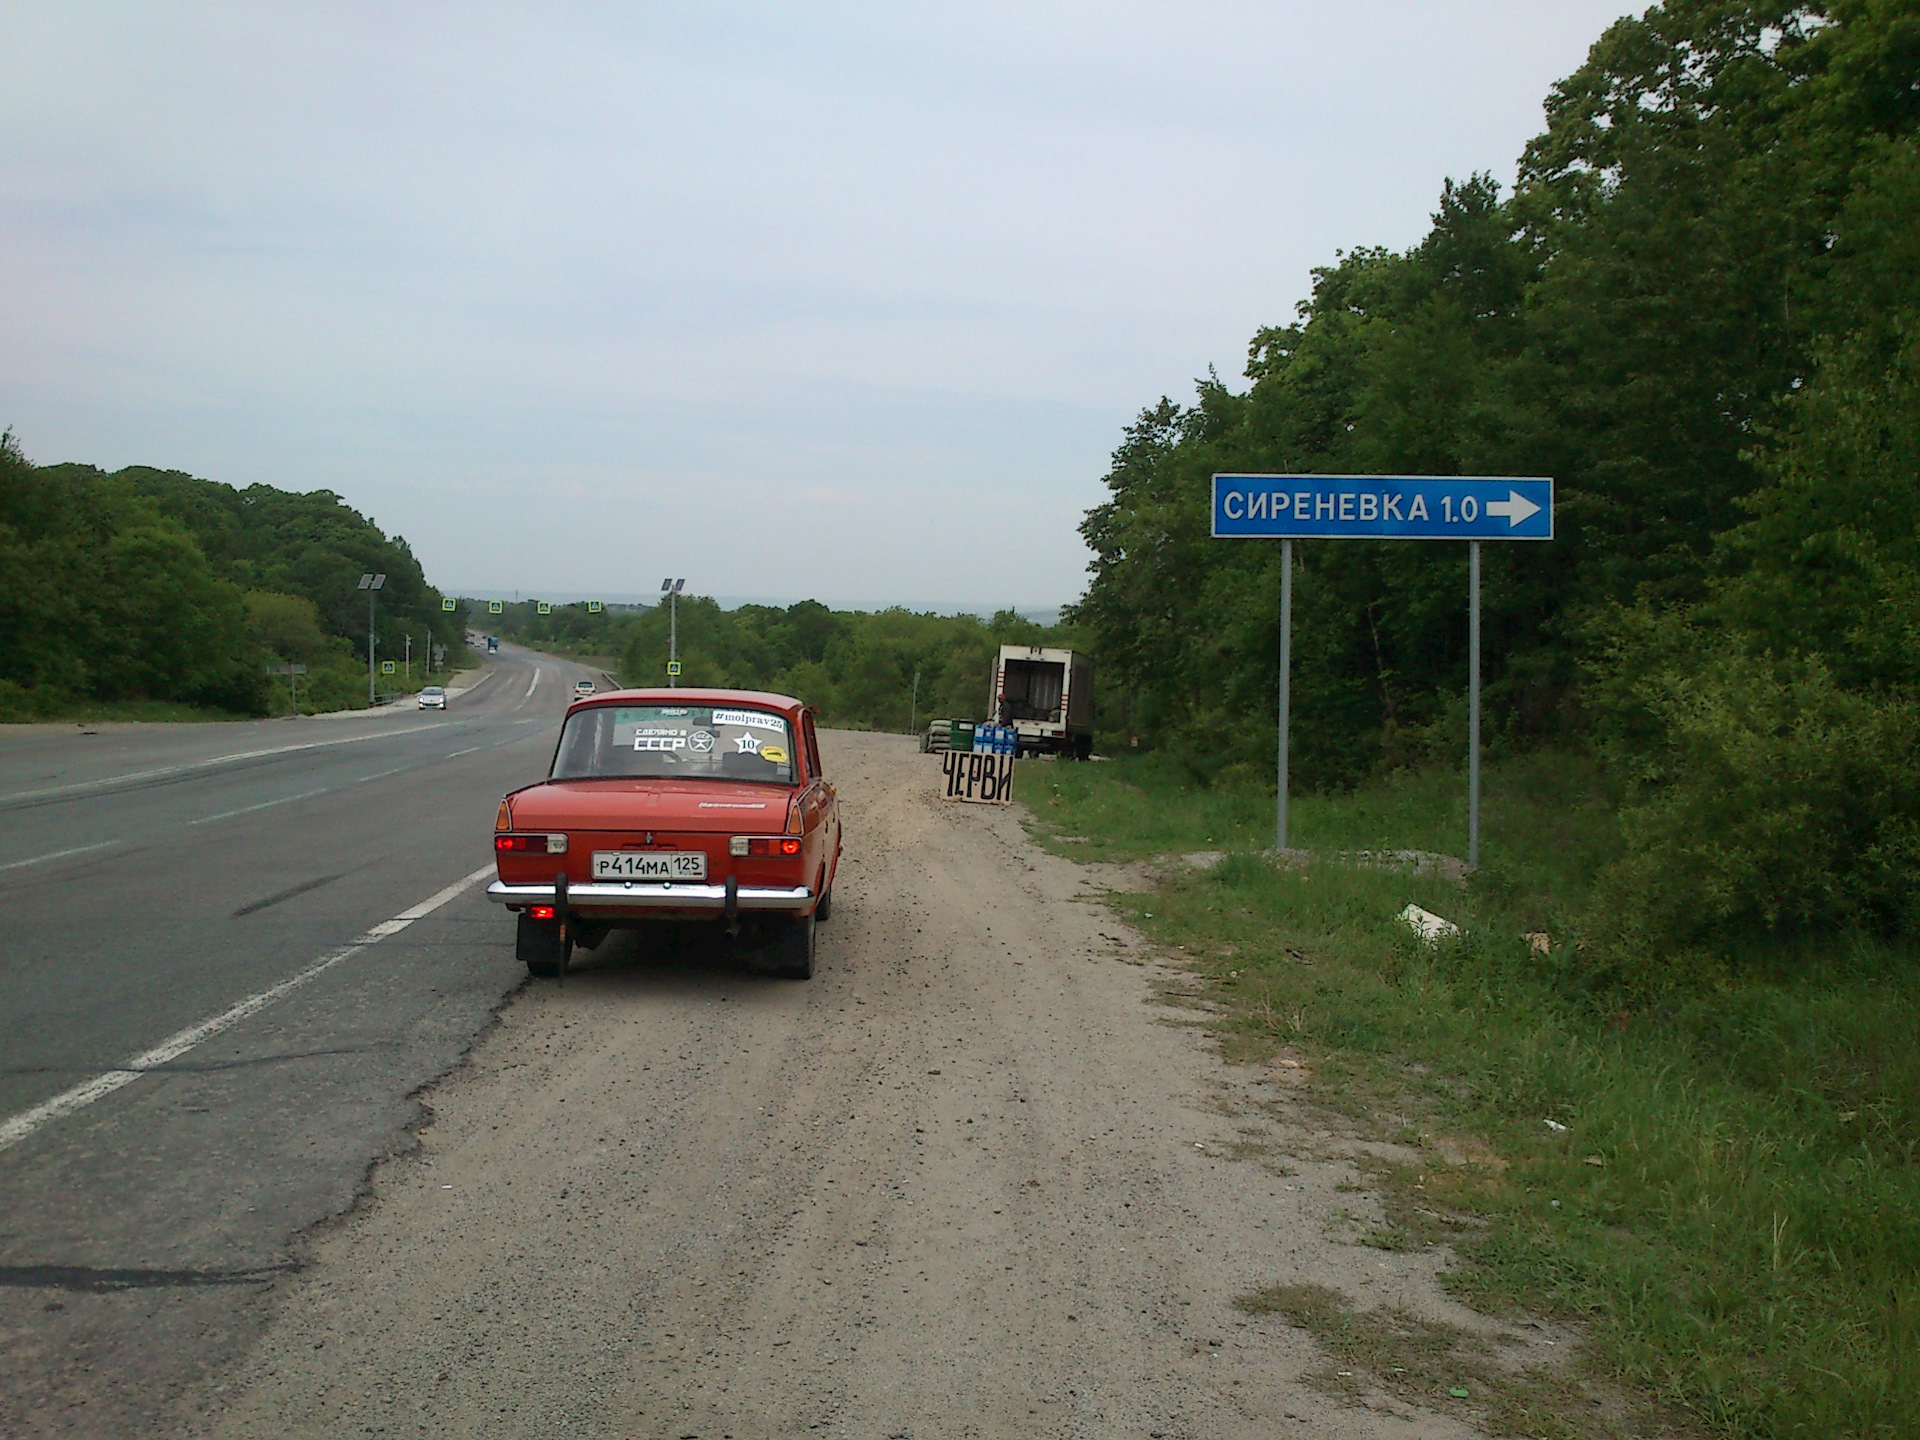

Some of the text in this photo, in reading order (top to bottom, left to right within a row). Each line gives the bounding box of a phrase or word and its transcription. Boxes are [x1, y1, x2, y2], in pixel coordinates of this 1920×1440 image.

[1223, 491, 1479, 523] СИРЕНЕВКА 1.0
[715, 713, 783, 729] #molprav25
[634, 737, 686, 751] СССР
[741, 739, 755, 749] 10
[942, 752, 1014, 801] ЧЕРВИ
[674, 857, 700, 871] 125
